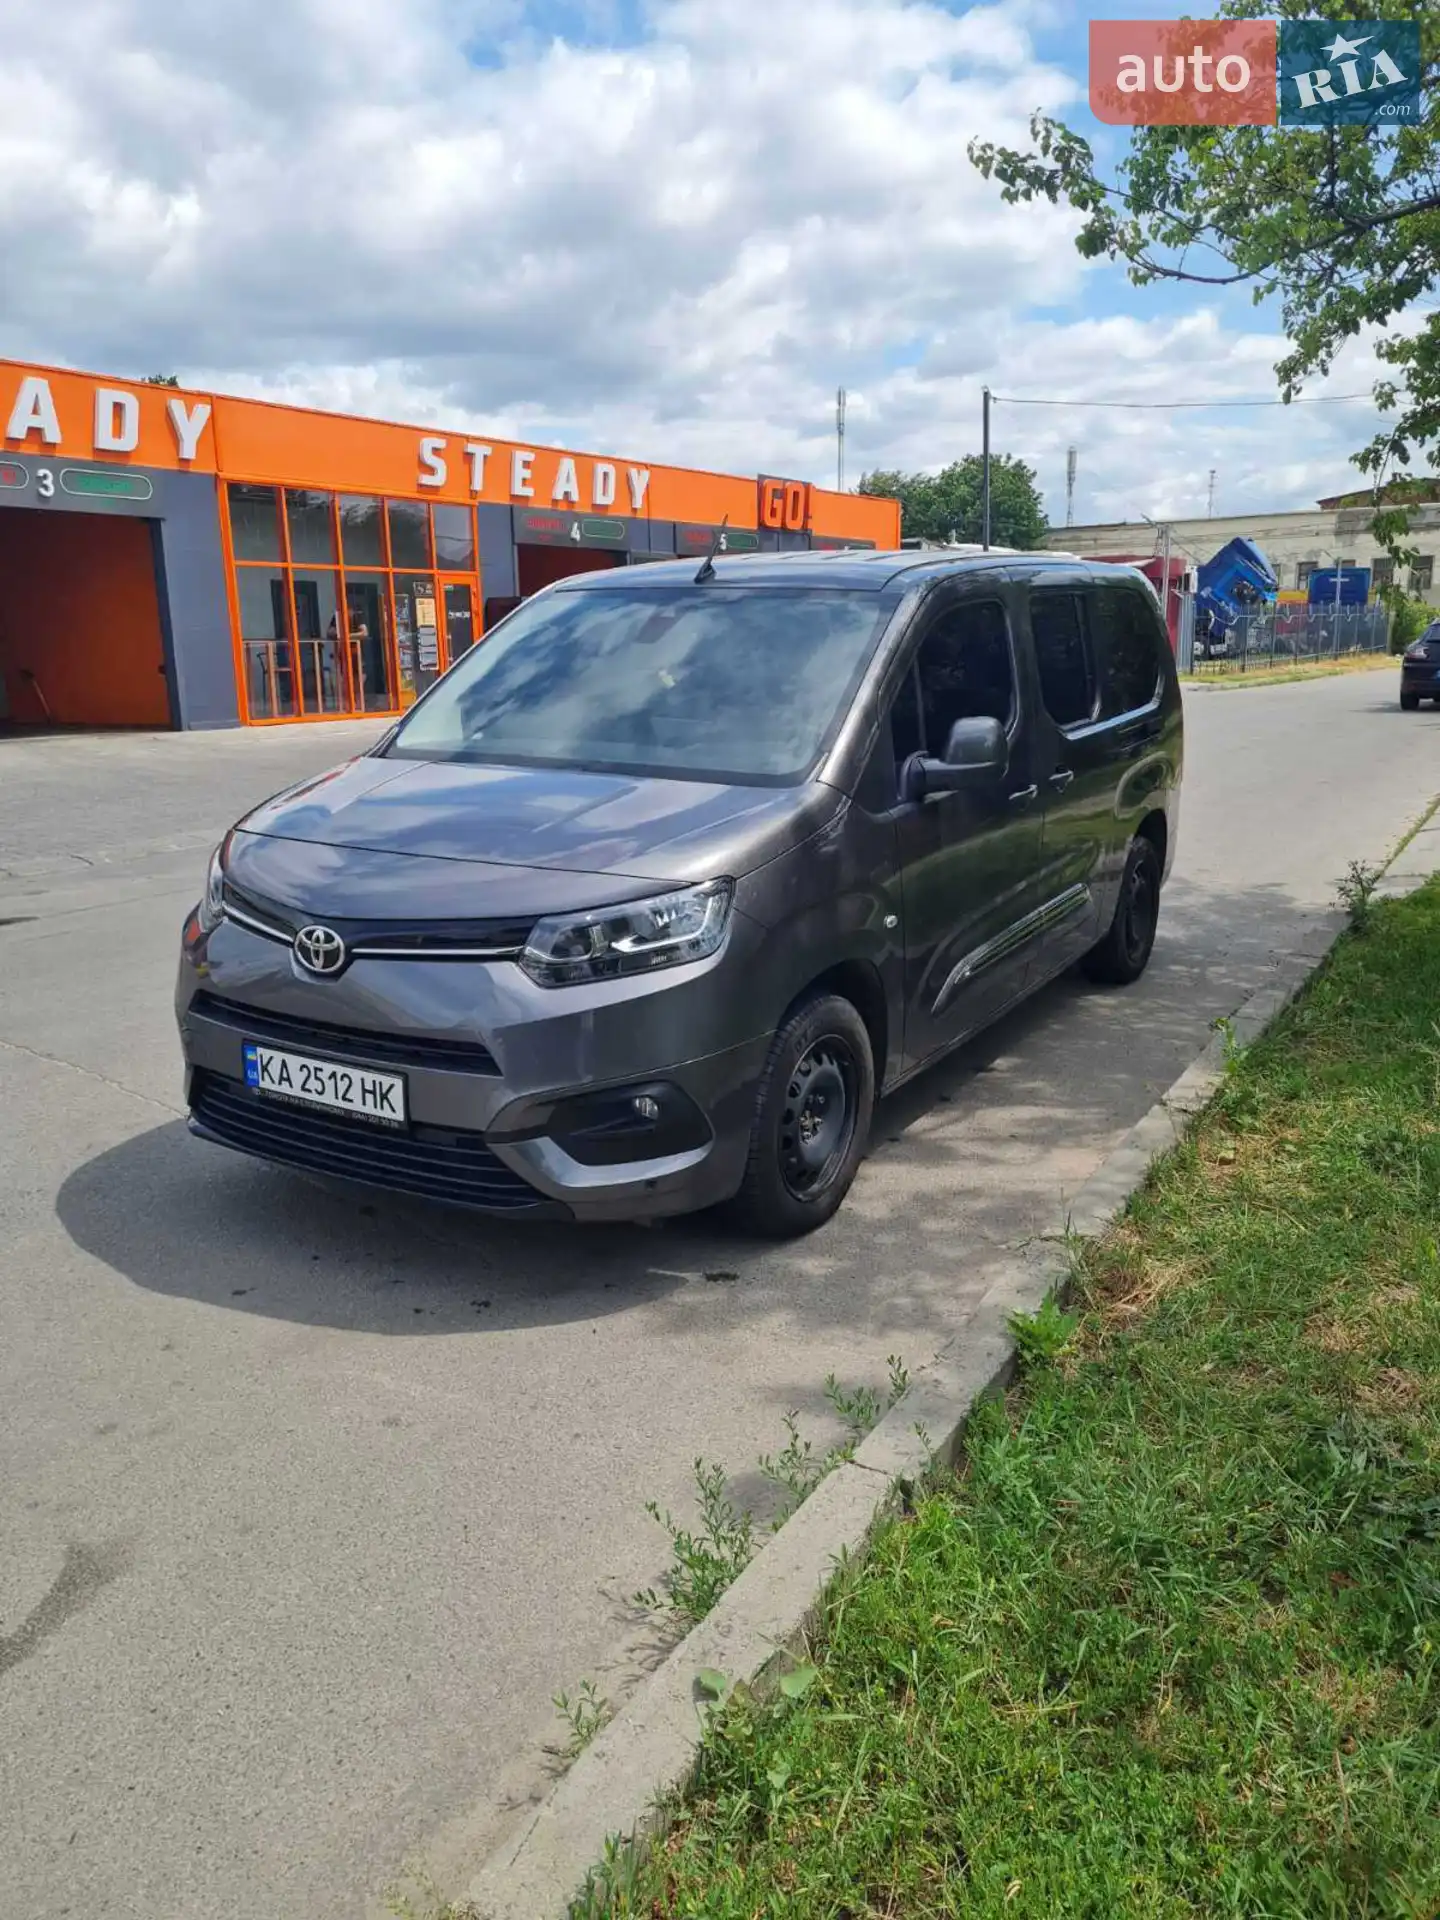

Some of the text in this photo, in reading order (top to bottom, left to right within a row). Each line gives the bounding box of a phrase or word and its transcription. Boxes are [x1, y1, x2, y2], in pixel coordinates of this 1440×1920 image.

[36, 469, 55, 498] 3
[417, 437, 650, 510] STEADY
[569, 521, 581, 542] 4
[259, 1053, 294, 1089] KA
[299, 1063, 354, 1104] 2512
[360, 1077, 397, 1114] HK
